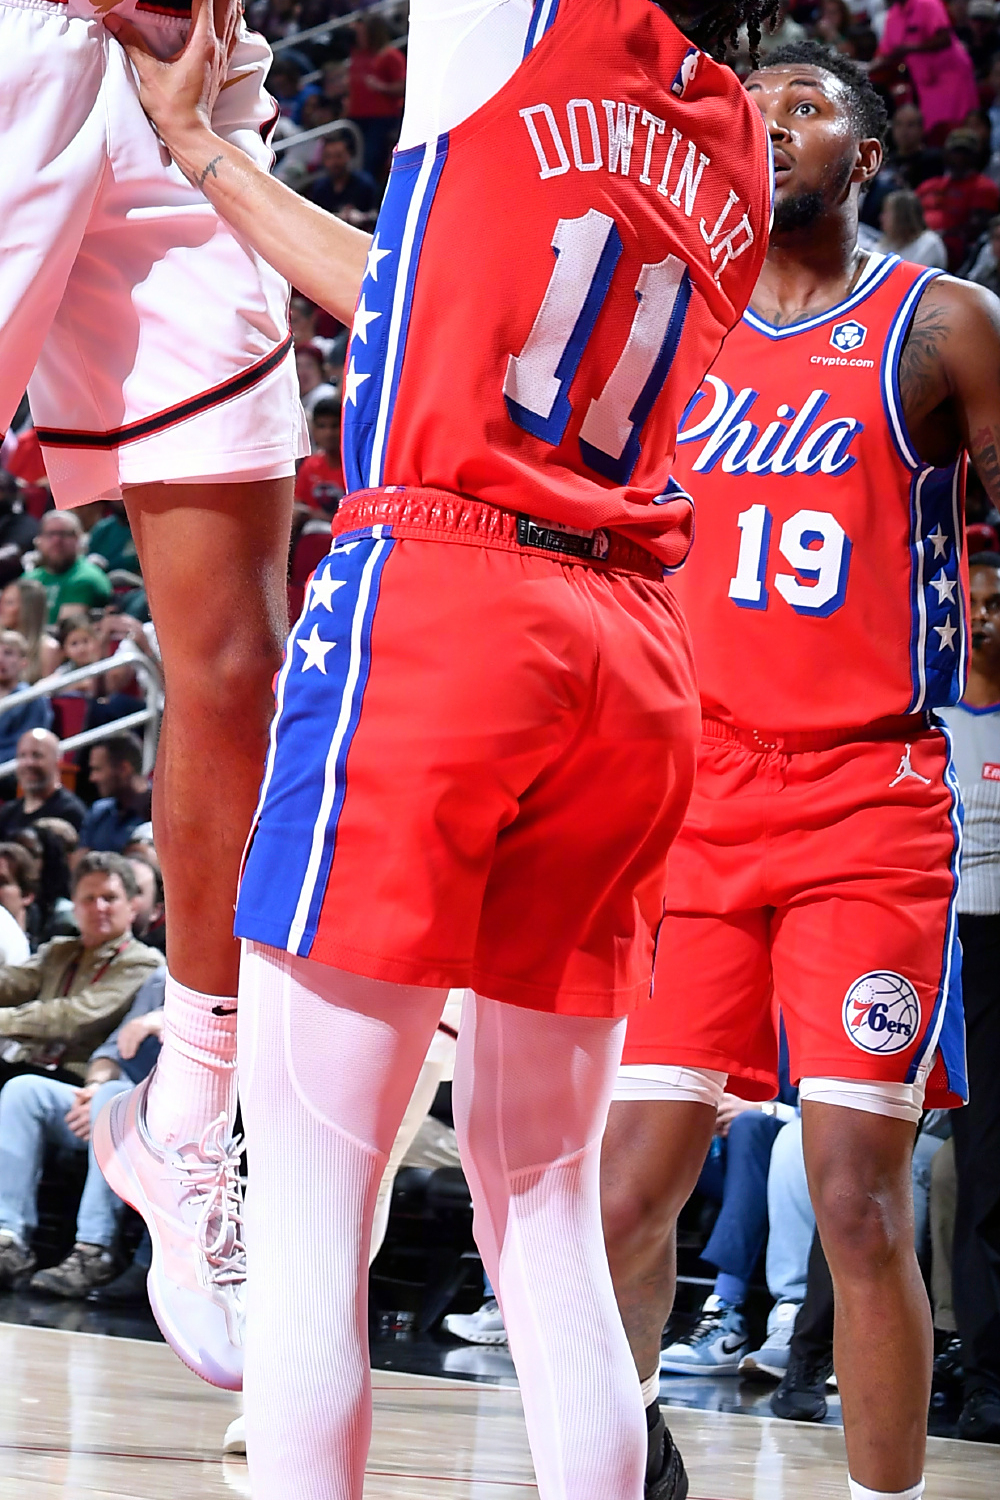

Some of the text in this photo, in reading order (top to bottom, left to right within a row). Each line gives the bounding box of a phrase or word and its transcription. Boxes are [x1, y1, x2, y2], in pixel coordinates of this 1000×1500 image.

[519, 98, 710, 217] DOWTIN
[503, 208, 693, 485] 11
[810, 354, 874, 369] crypto.com
[677, 374, 864, 477] Phila
[728, 504, 853, 618] 19
[851, 998, 912, 1037] 76ers
